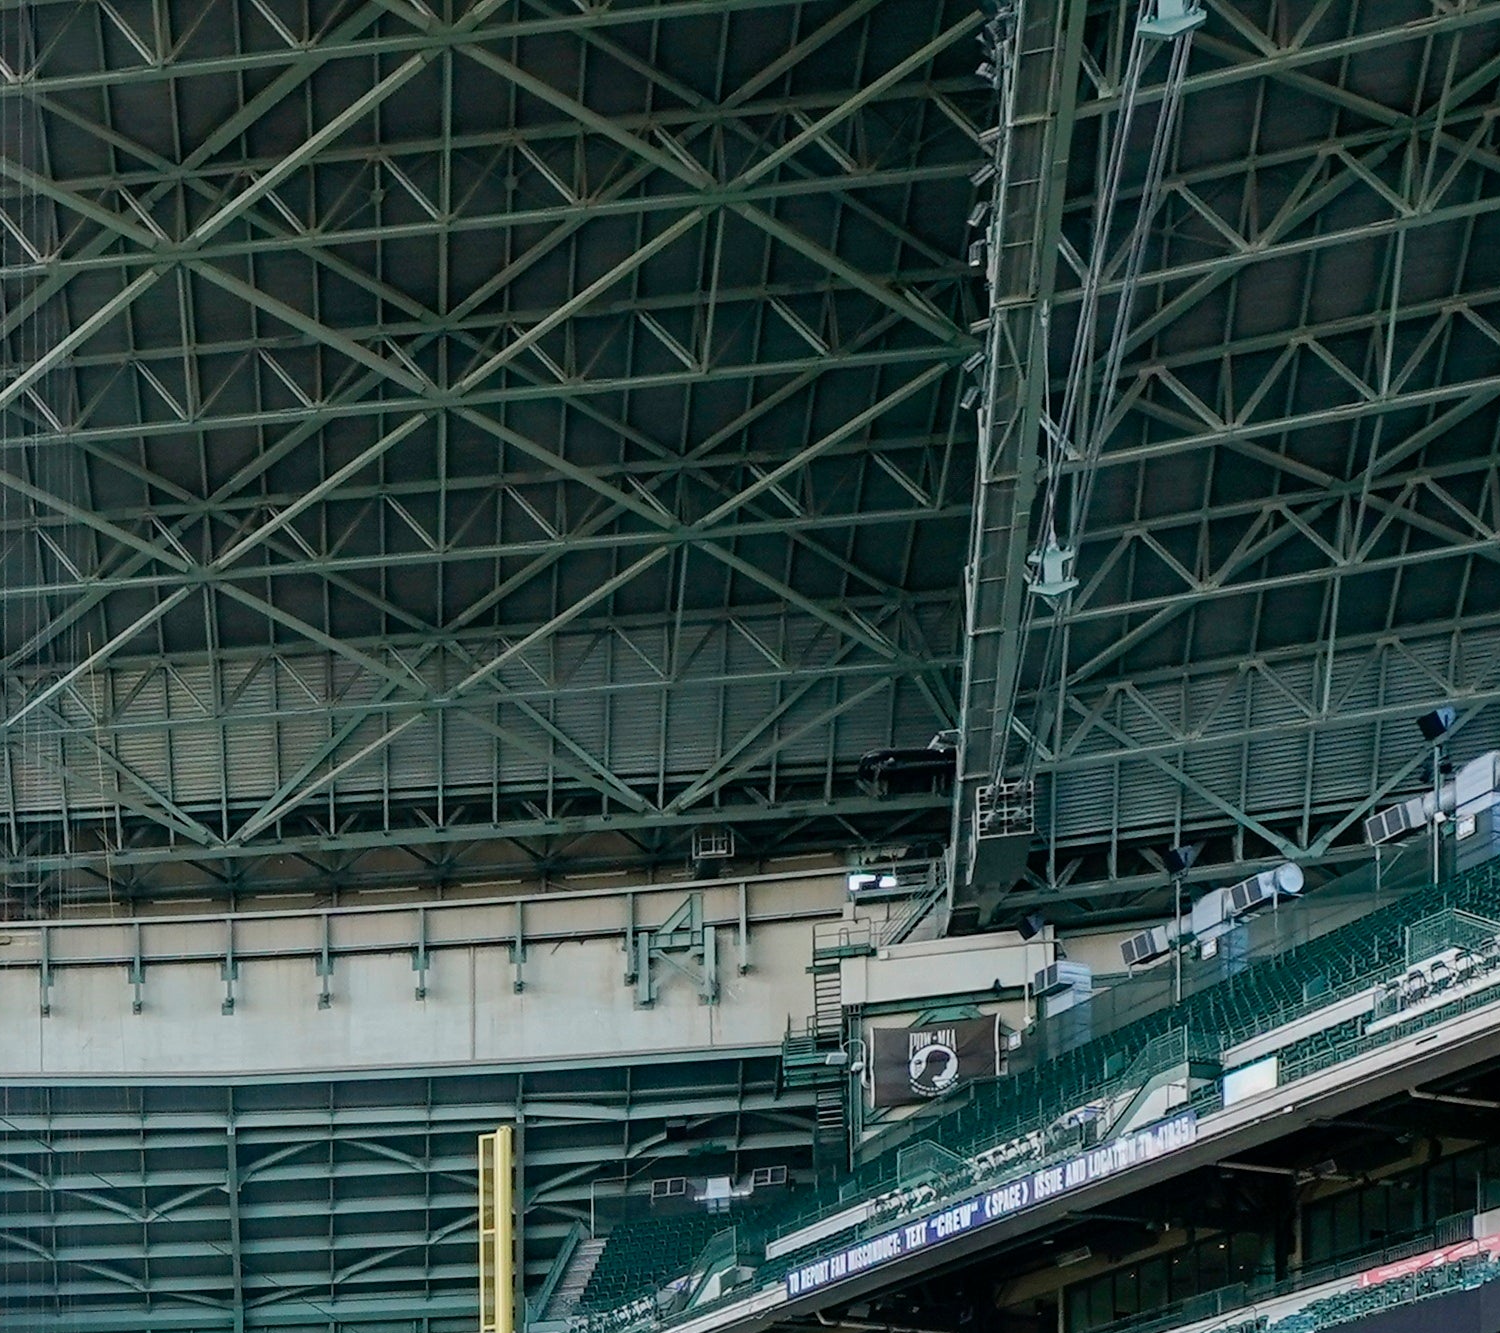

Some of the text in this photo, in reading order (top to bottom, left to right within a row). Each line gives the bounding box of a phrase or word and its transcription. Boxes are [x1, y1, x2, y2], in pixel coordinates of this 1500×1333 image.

[801, 1260, 830, 1290] REPORT
[905, 1221, 927, 1249] TEXT
[1034, 1167, 1063, 1199] ISSUE
[1065, 1159, 1086, 1187] AND
